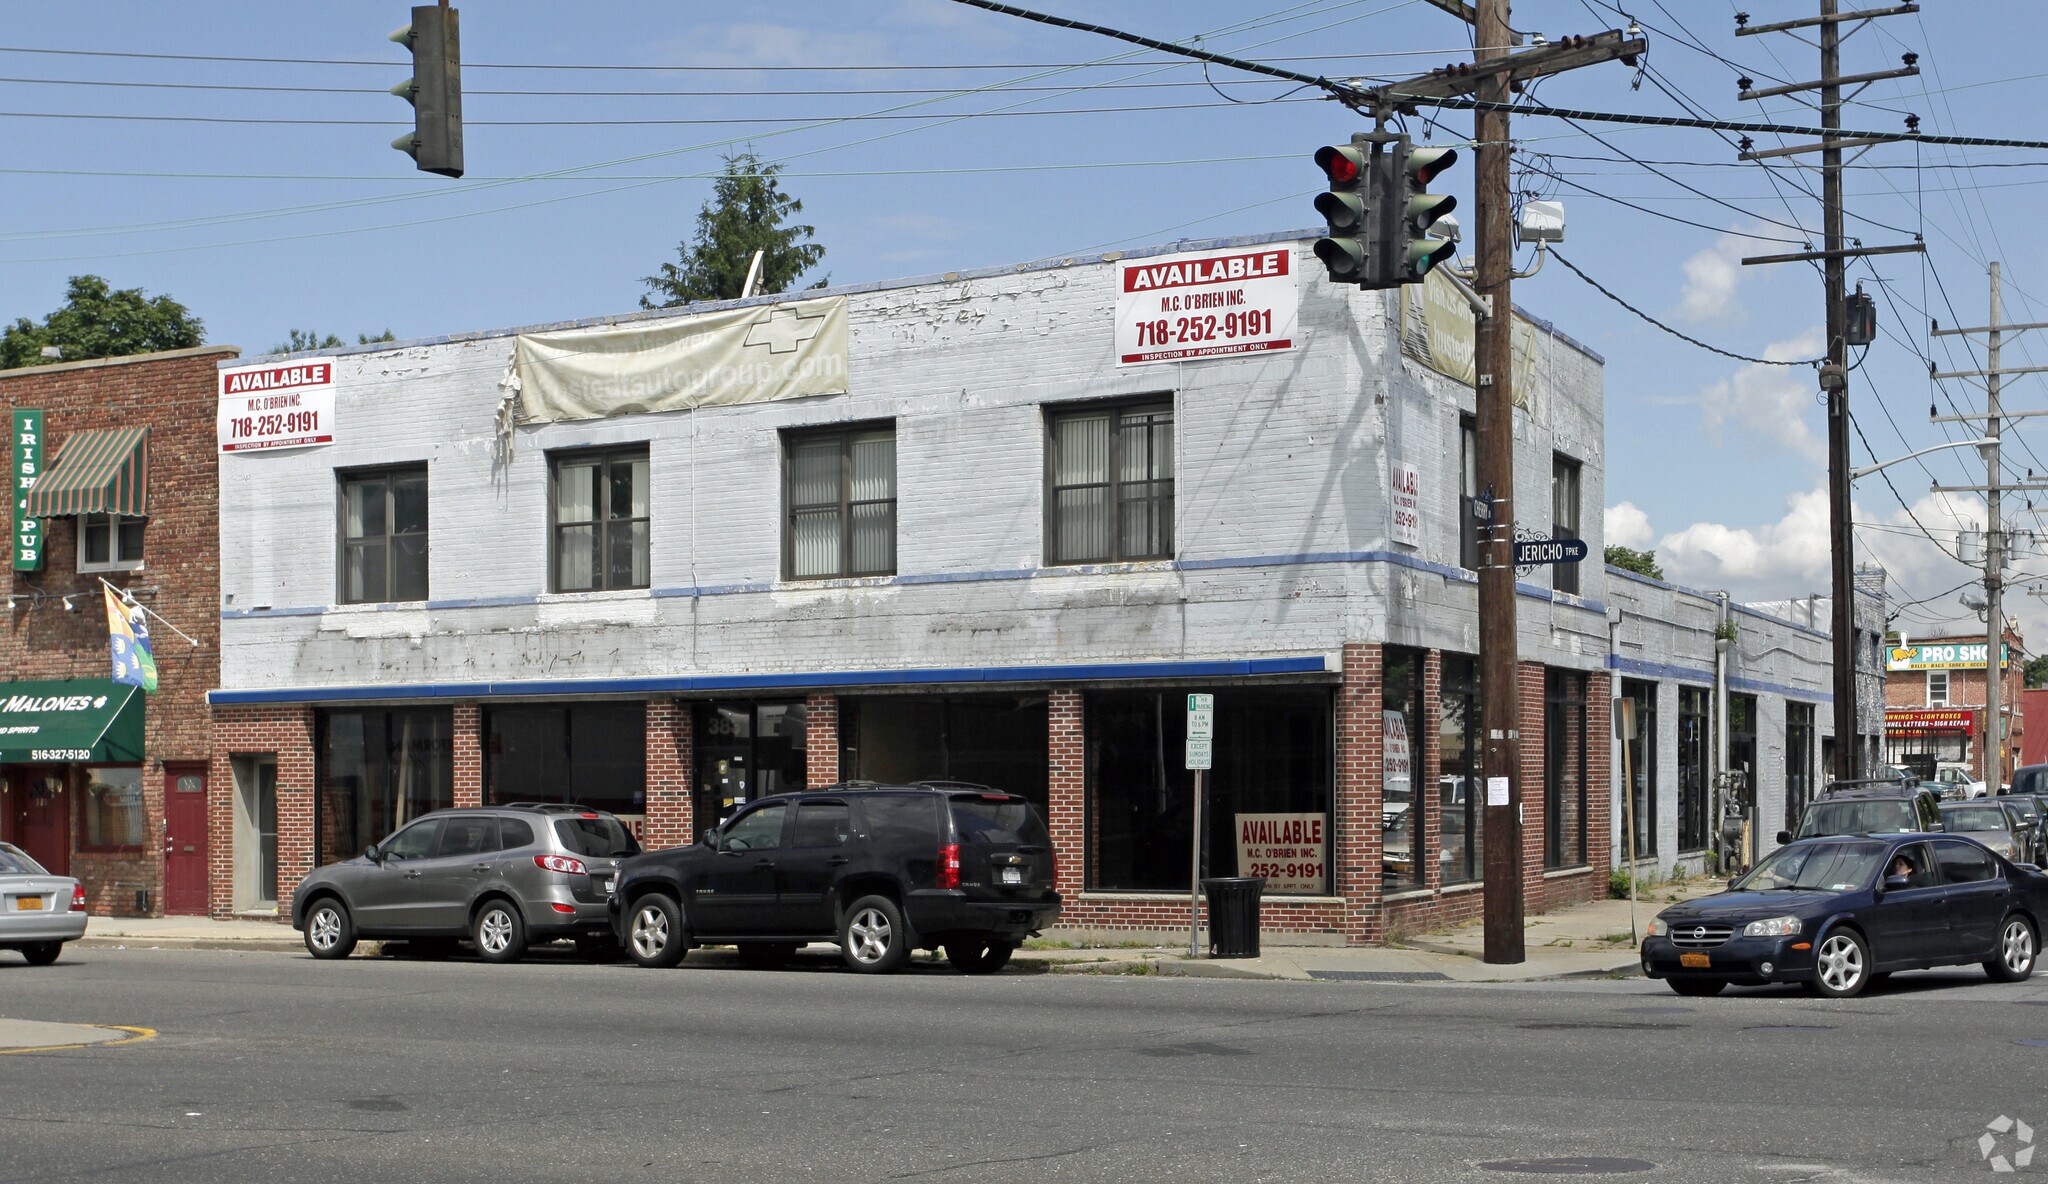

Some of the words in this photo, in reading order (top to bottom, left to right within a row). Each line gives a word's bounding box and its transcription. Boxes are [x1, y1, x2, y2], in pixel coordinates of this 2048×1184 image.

[1133, 253, 1279, 290] AVAILABLE
[1161, 295, 1182, 313] M.C.
[1184, 291, 1224, 311] O'BRIEN
[1226, 288, 1246, 307] INC.
[1447, 292, 1457, 314] us
[1458, 300, 1469, 321] on
[1135, 308, 1272, 347] 718-252-9191
[1141, 350, 1183, 361] INSPECTION
[1186, 349, 1195, 357] BY
[1198, 344, 1247, 356] APPOINTMENT
[1249, 342, 1268, 351] ONLY
[229, 365, 325, 392] AVAILABLE
[248, 399, 262, 412] M.C.
[263, 396, 288, 410] O'BRIEN
[289, 393, 302, 407] INC.
[231, 410, 318, 438] 718-252-9191
[20, 419, 37, 488] IRISH
[20, 520, 37, 561] PUB
[1518, 543, 1563, 562] JERICHO
[1565, 546, 1579, 556] TPKE
[1922, 646, 1955, 662] PRO
[2, 695, 93, 713] MALONES
[8, 726, 40, 734] SPIRITS
[32, 750, 90, 760] 516-327-5120
[1242, 820, 1322, 845] AVAILABLE
[1247, 848, 1262, 858] M.C.
[1265, 848, 1297, 858] O'BRIEN
[1300, 848, 1317, 858] INC.
[1250, 863, 1323, 878] 252-9191
